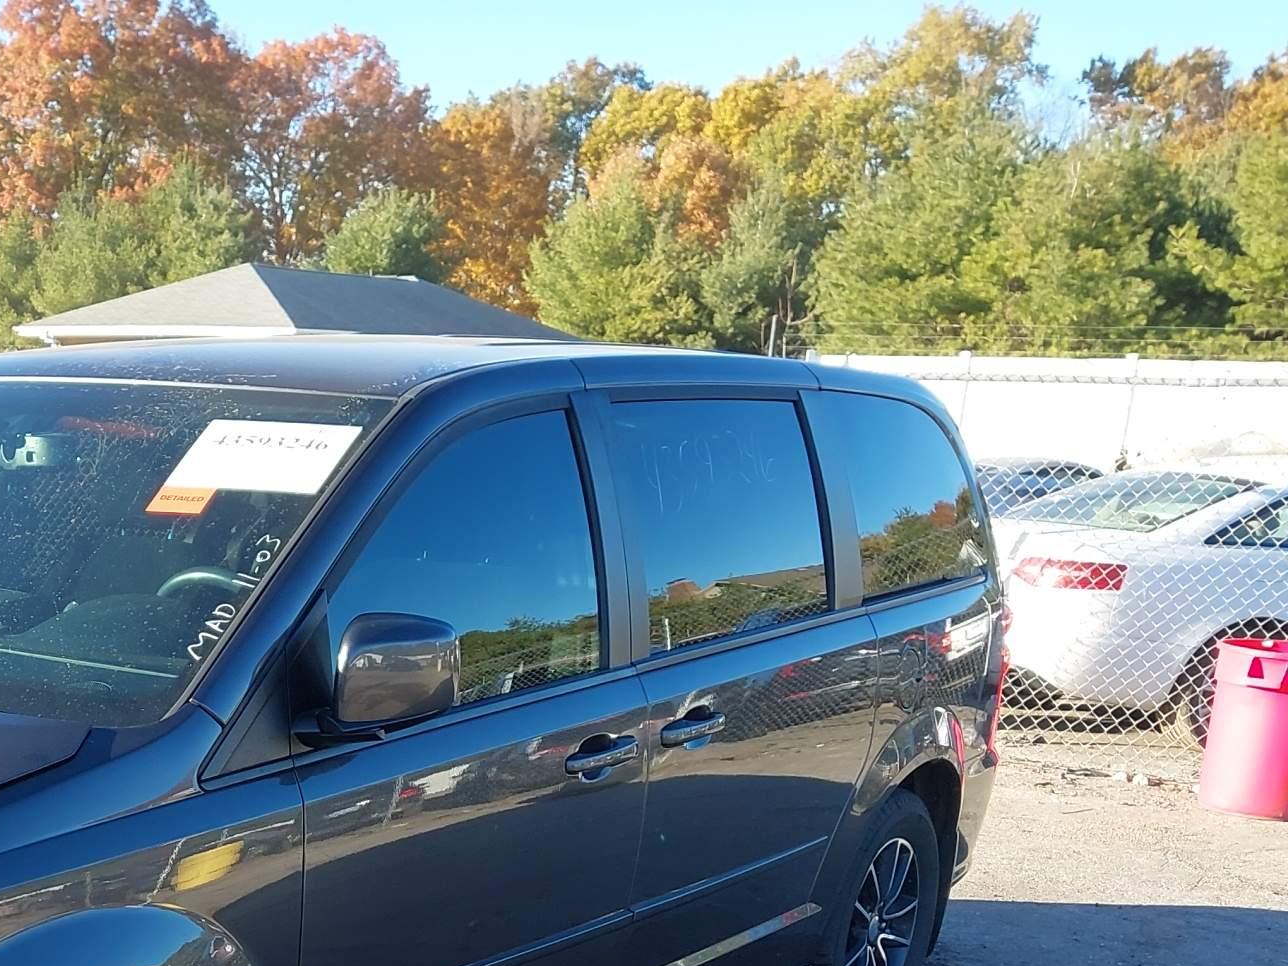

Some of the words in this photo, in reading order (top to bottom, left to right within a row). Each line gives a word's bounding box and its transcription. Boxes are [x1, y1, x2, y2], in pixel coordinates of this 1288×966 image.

[159, 494, 205, 502] DETAILED
[187, 603, 236, 660] MAD
[232, 534, 281, 588] 11-03
